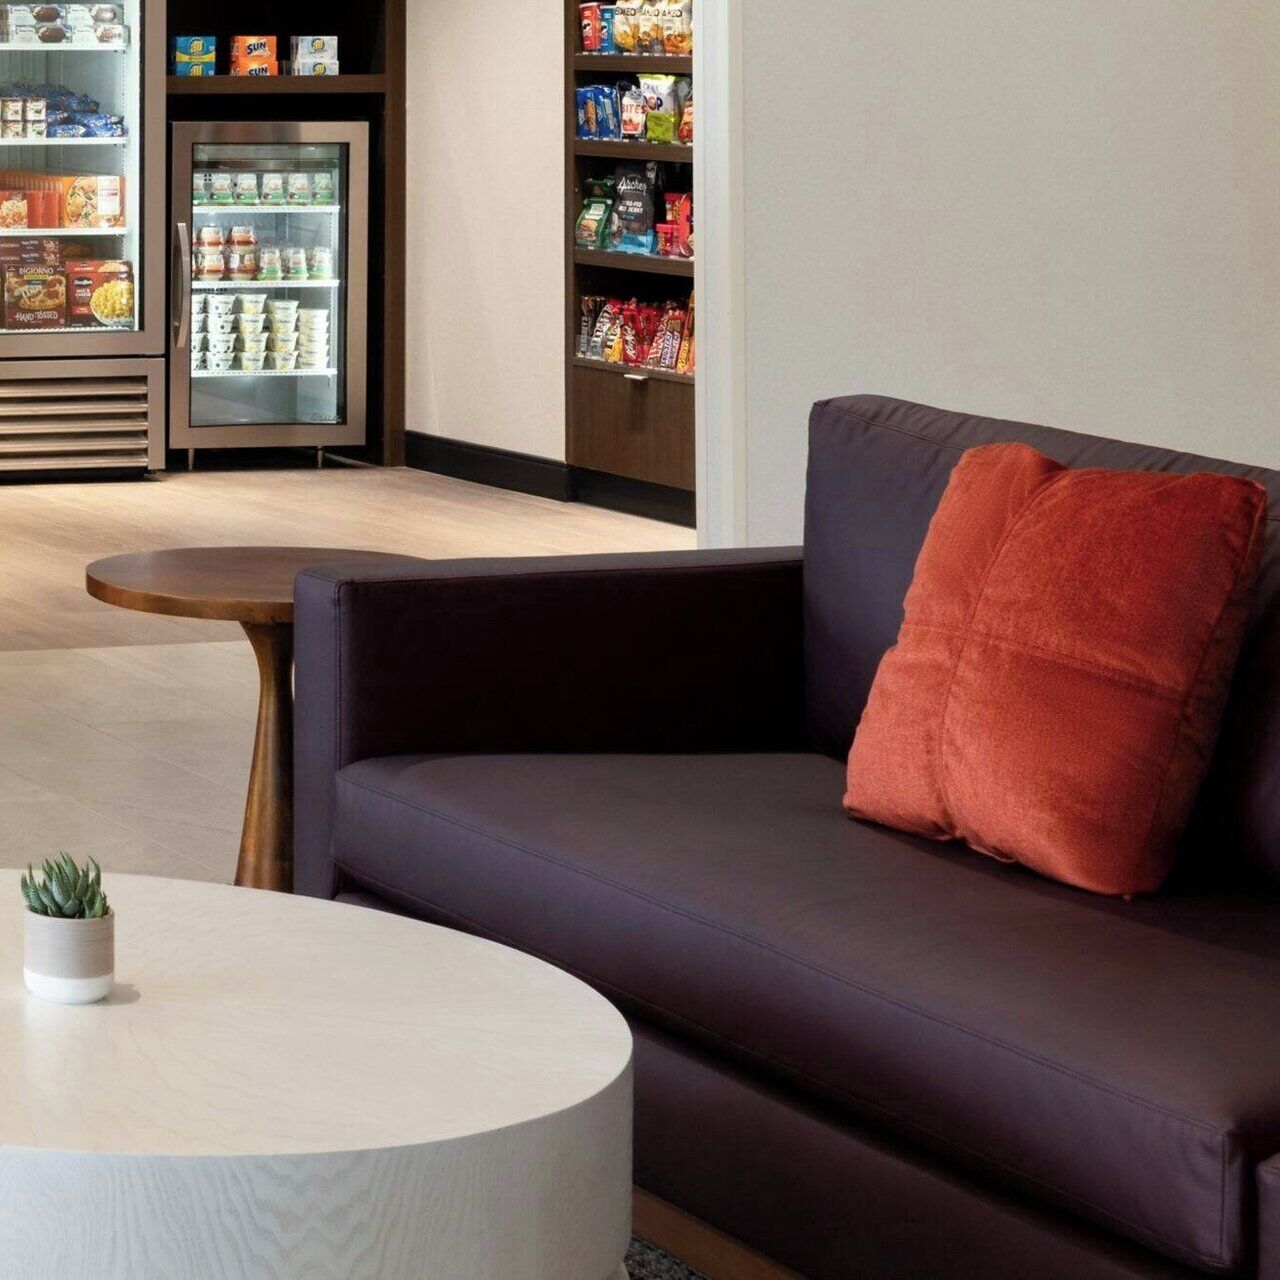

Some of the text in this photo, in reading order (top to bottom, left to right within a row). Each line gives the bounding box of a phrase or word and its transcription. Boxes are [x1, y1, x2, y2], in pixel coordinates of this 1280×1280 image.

[661, 8, 683, 18] AKED
[246, 41, 267, 55] SUN
[248, 66, 268, 76] SUN
